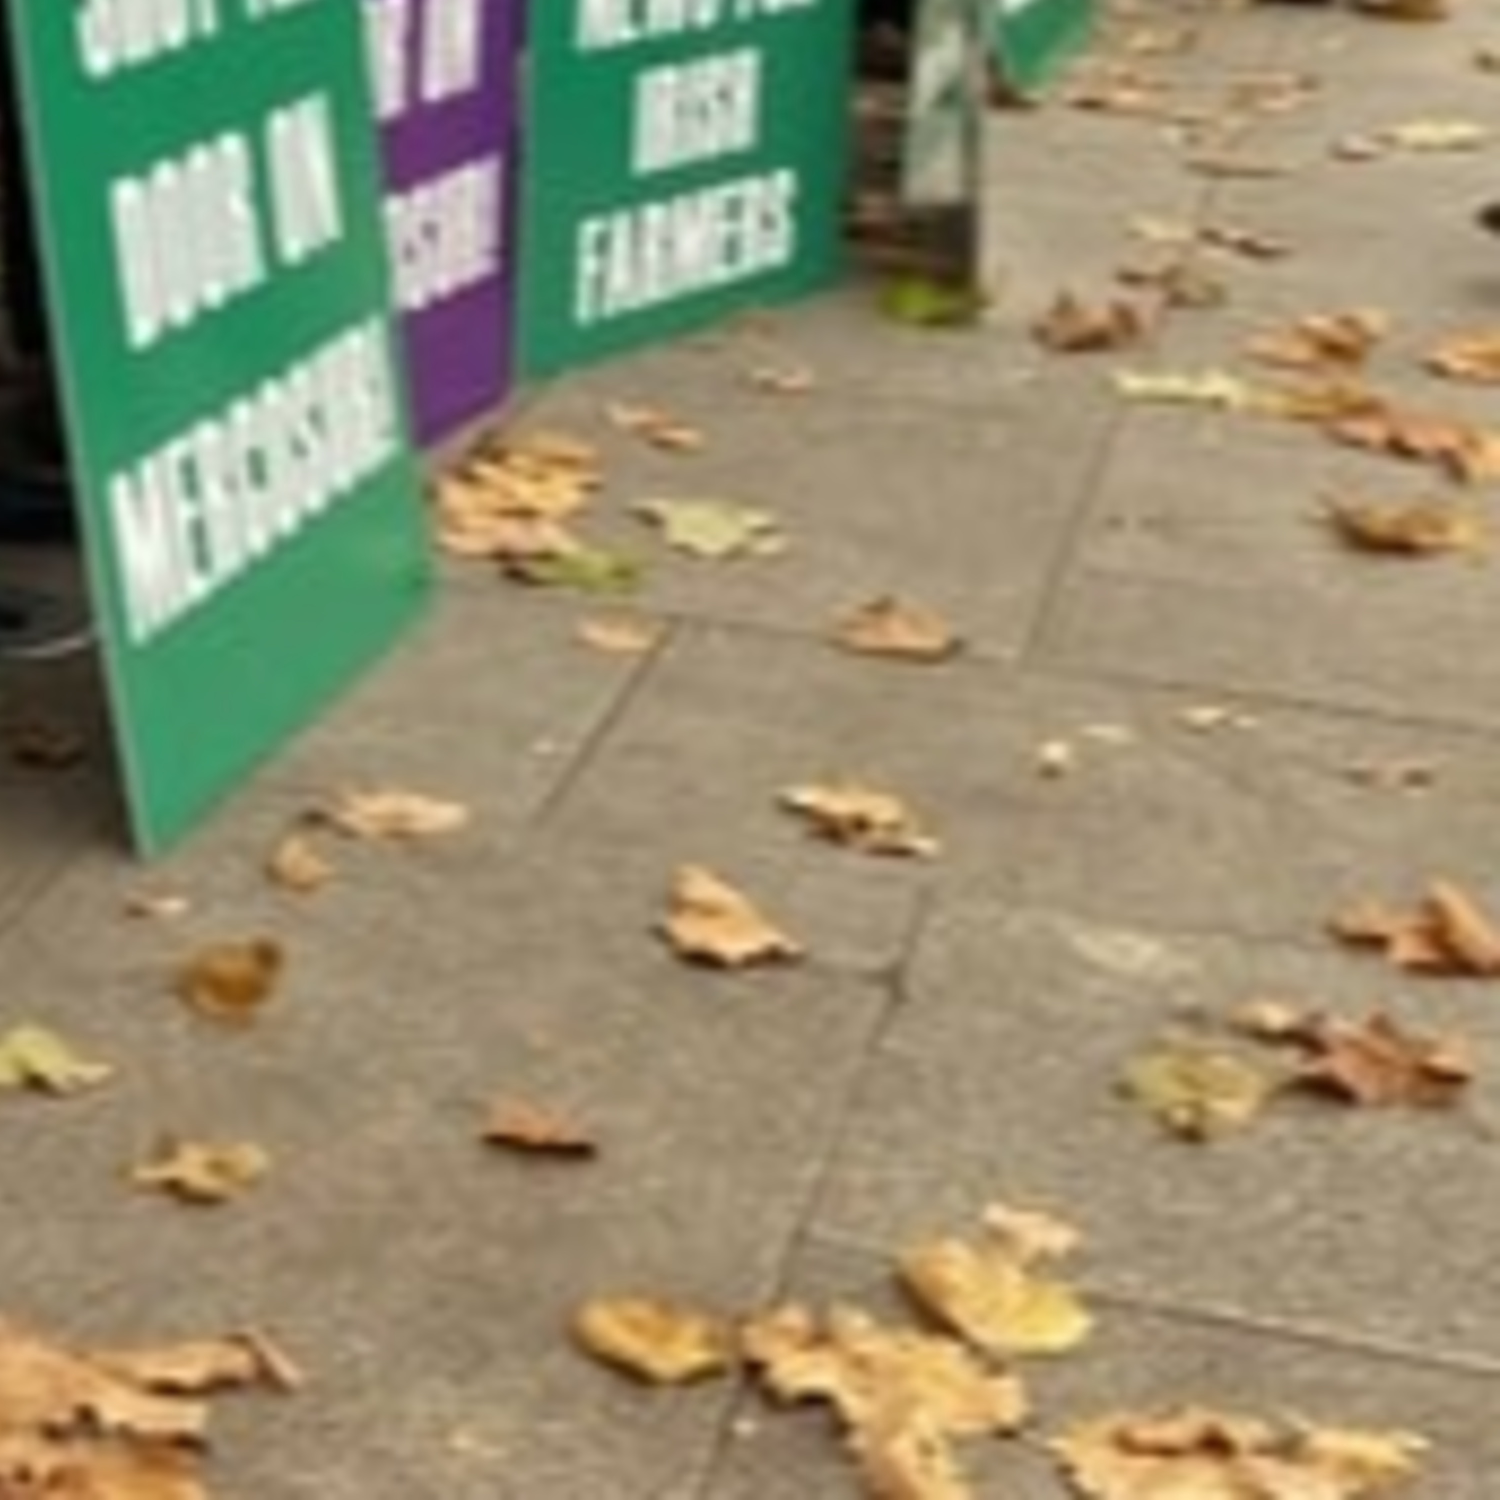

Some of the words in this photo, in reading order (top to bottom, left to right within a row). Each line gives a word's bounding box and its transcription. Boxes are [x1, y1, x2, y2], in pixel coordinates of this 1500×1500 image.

[630, 47, 761, 175] IRISH
[109, 130, 267, 351] DOOR
[266, 91, 344, 266] ON
[576, 169, 797, 326] FARMERS
